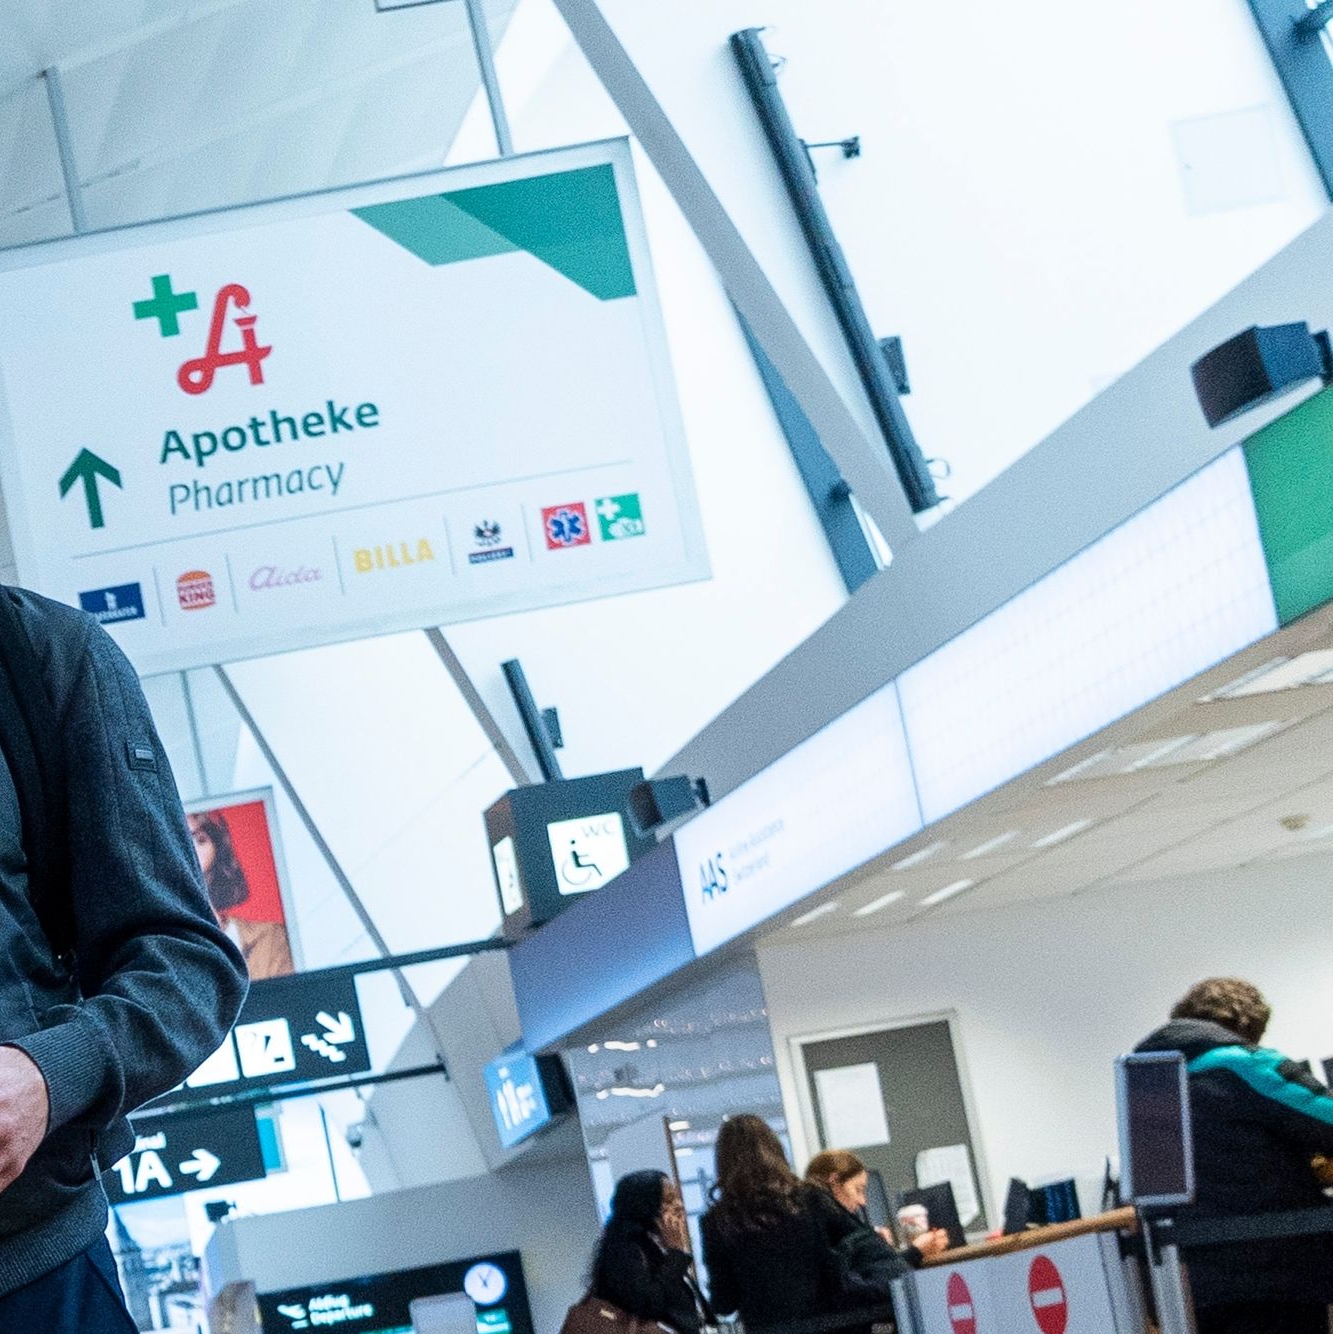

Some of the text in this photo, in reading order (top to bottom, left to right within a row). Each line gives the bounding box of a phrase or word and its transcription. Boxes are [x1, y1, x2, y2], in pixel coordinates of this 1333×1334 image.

[158, 399, 380, 468] Apotheke
[168, 461, 346, 516] Pharmacy
[353, 537, 435, 574] BILLA
[580, 820, 616, 838] WC
[699, 851, 729, 905] AAS
[111, 1150, 174, 1195] 1A
[309, 1303, 374, 1326] Departure
